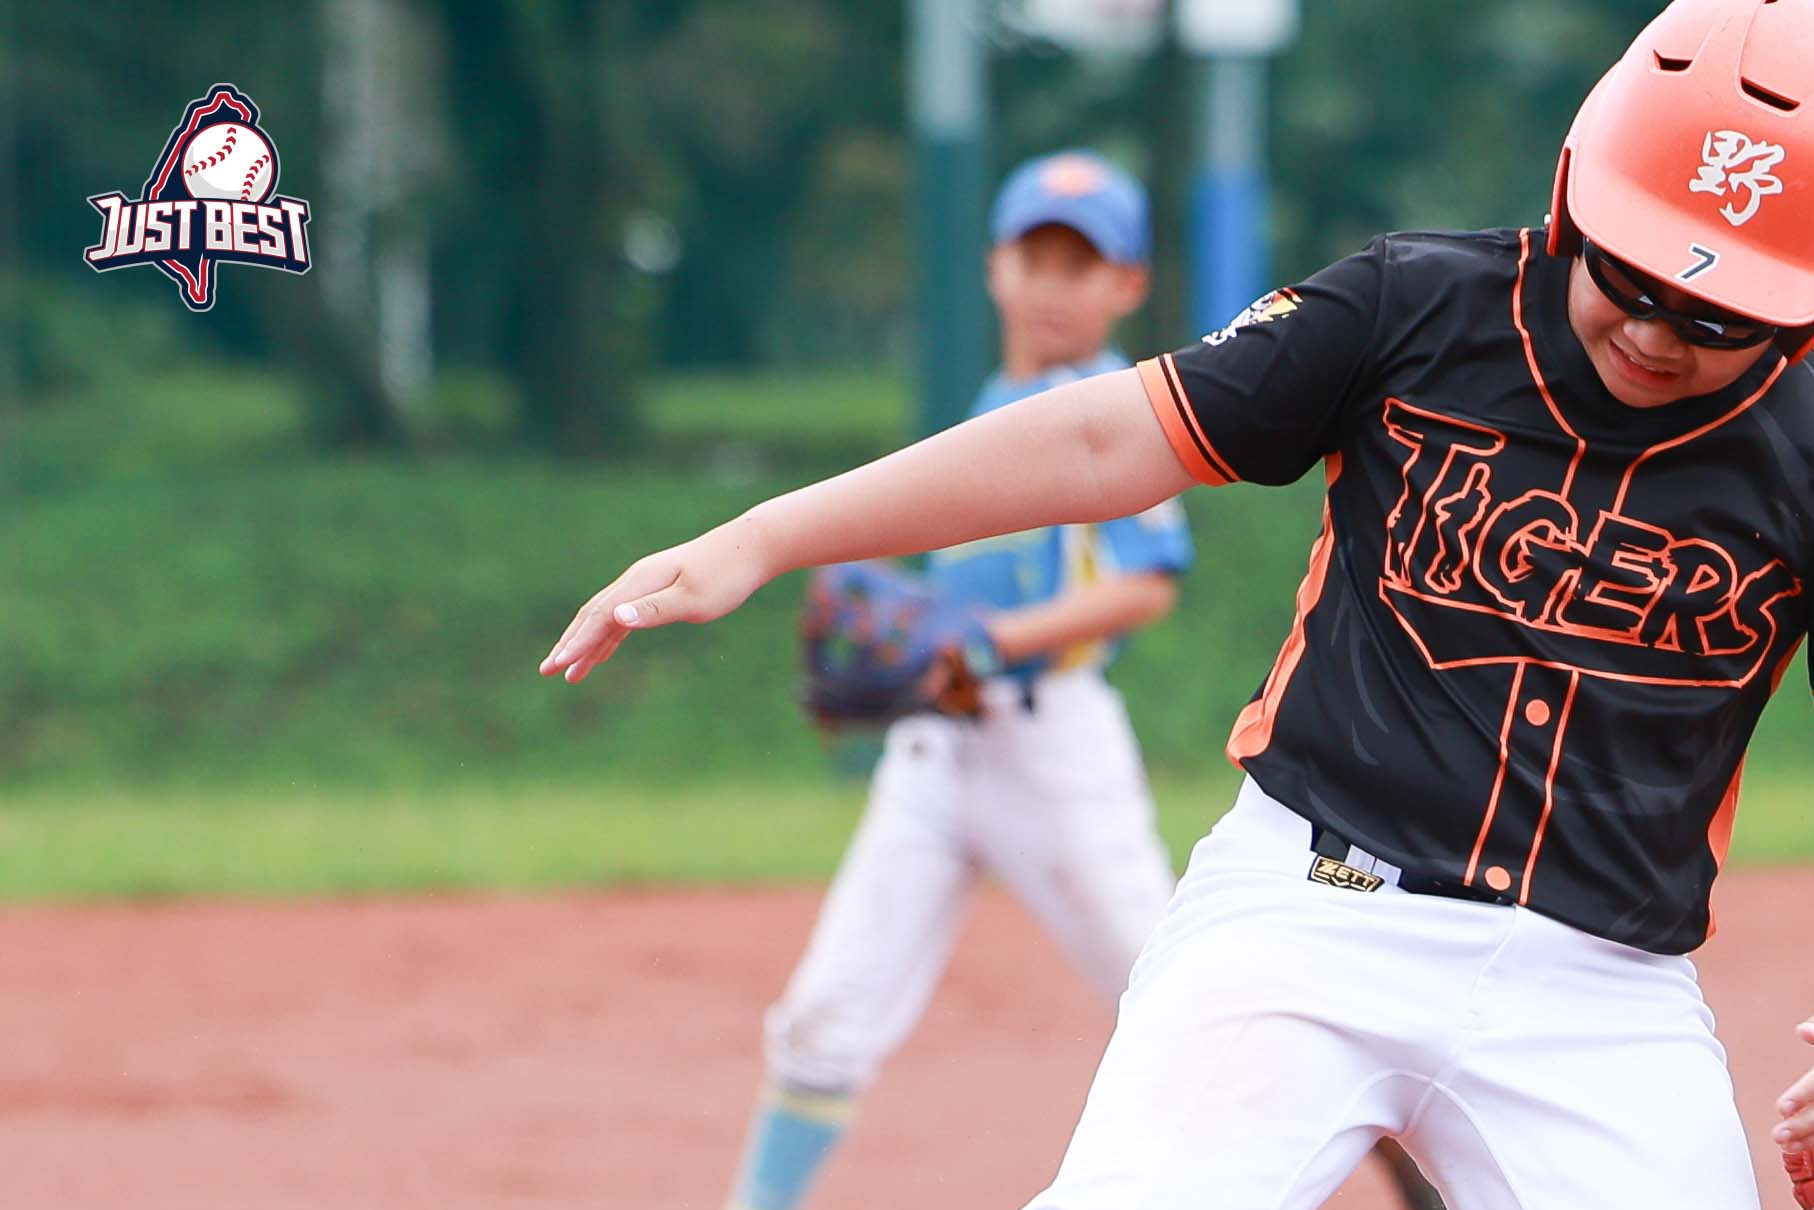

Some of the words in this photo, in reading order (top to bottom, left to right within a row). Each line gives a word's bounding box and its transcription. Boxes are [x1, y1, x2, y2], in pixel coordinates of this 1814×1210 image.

[1688, 129, 1786, 227] 野
[1674, 241, 1721, 284] 7
[1382, 397, 1803, 657] TIGERS
[1317, 860, 1376, 888] ZETT
